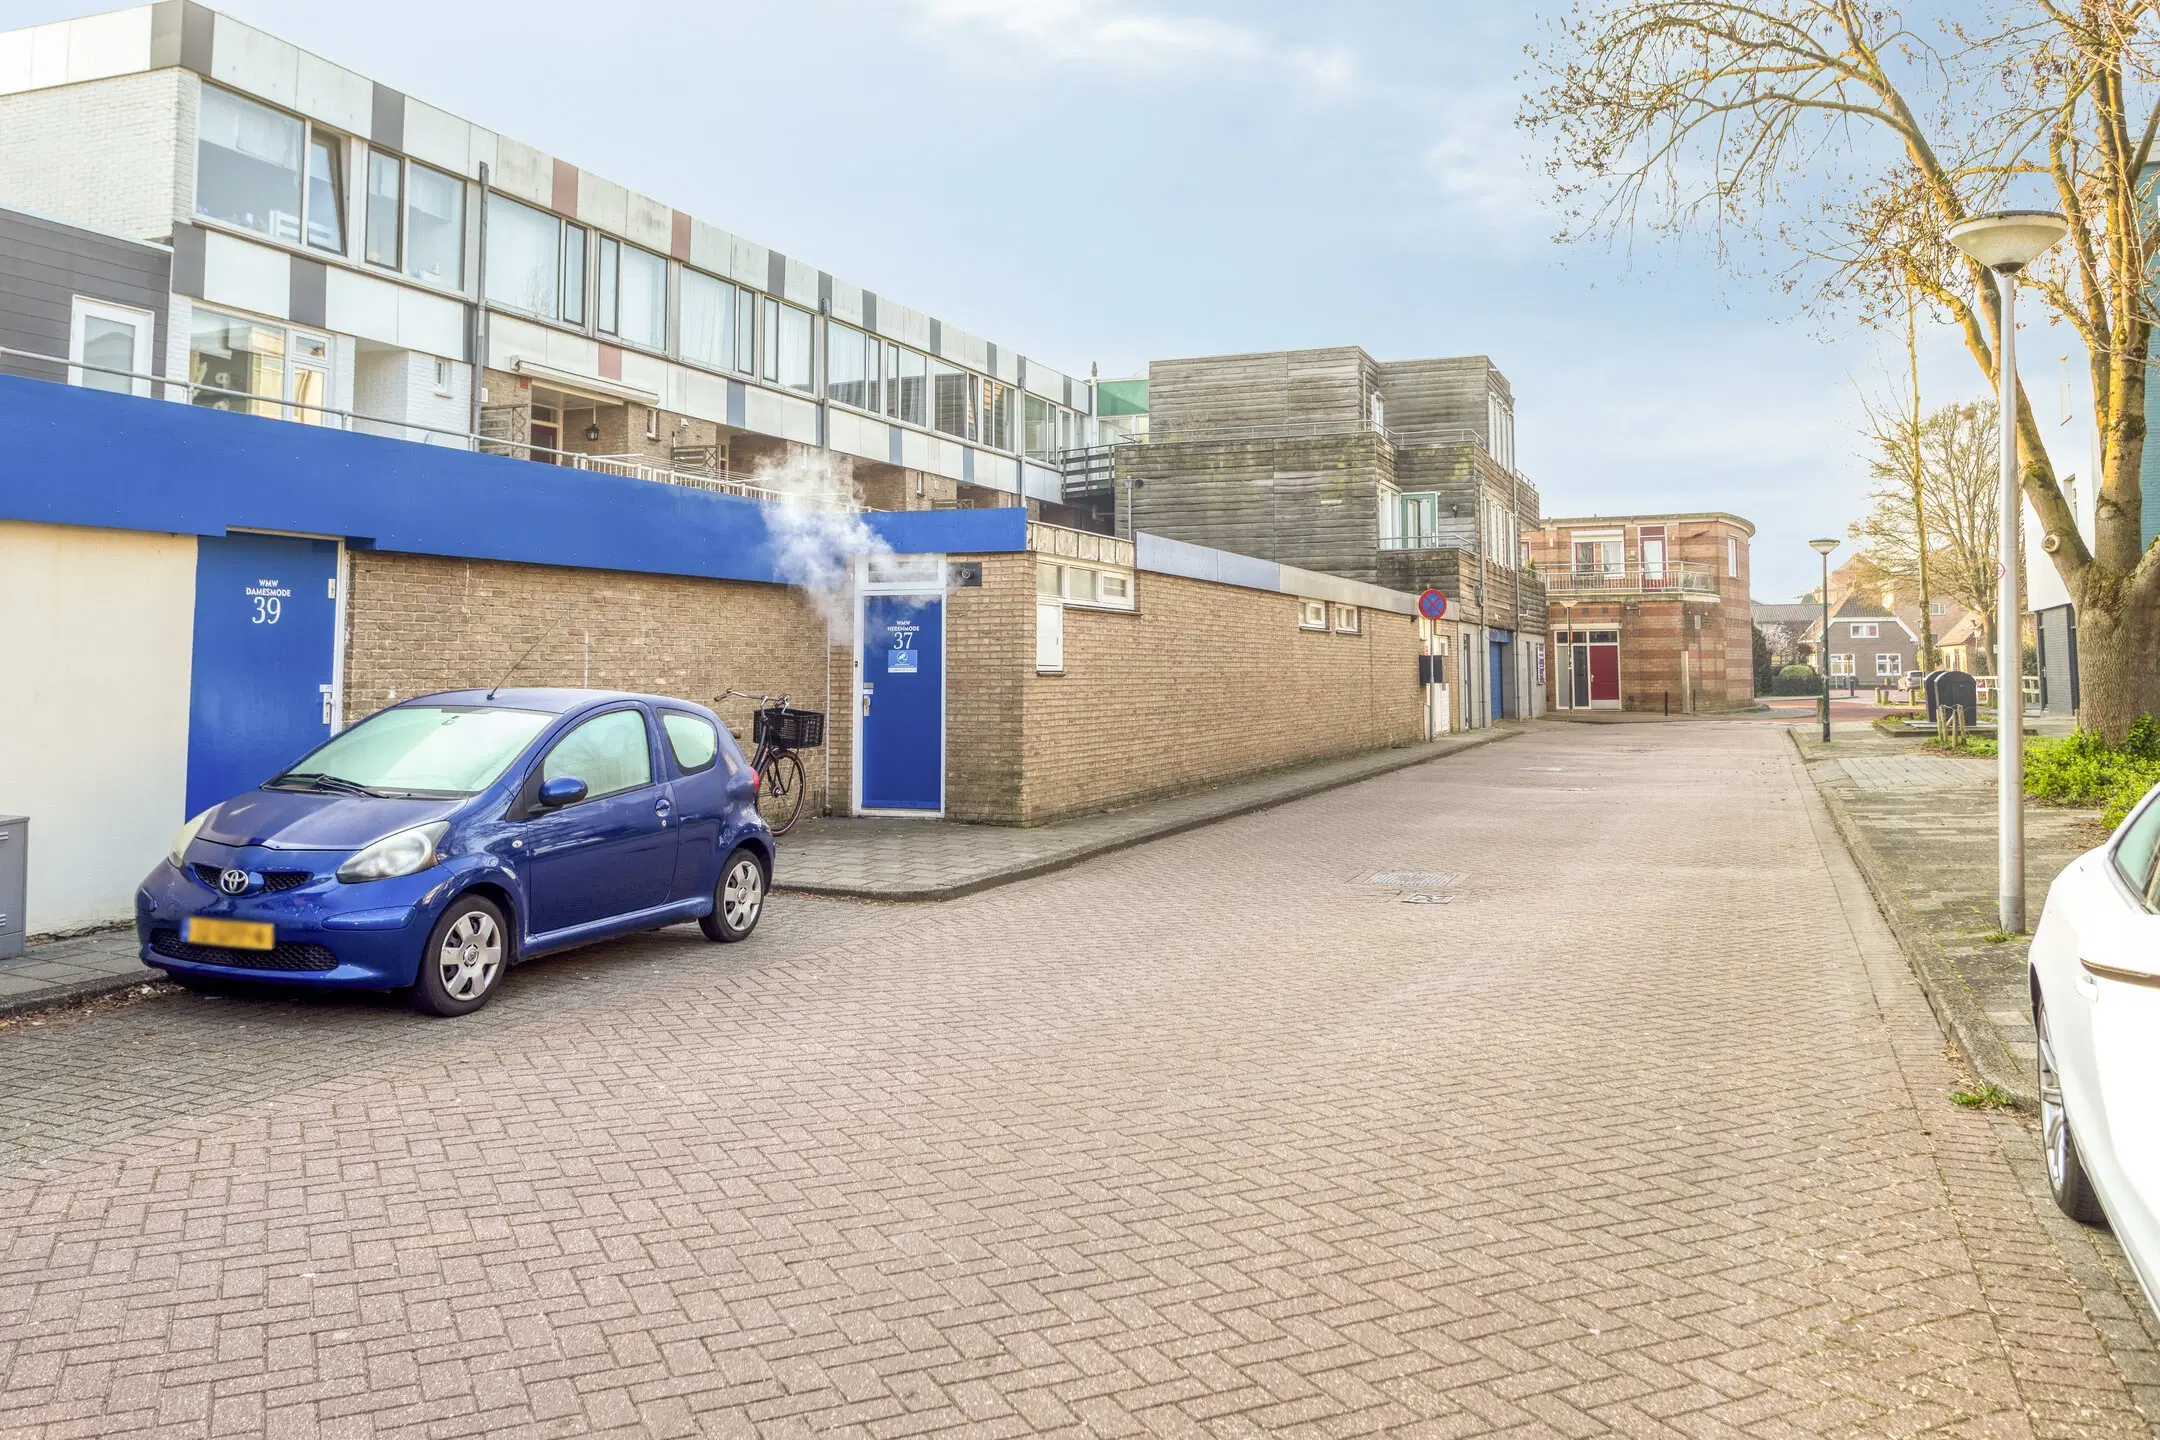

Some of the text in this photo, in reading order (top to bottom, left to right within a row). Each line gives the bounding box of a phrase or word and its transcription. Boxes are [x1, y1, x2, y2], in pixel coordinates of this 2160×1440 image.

[258, 579, 279, 587] WMW
[245, 587, 292, 597] DAMESMODE
[252, 596, 281, 624] 39
[893, 631, 913, 650] 37
